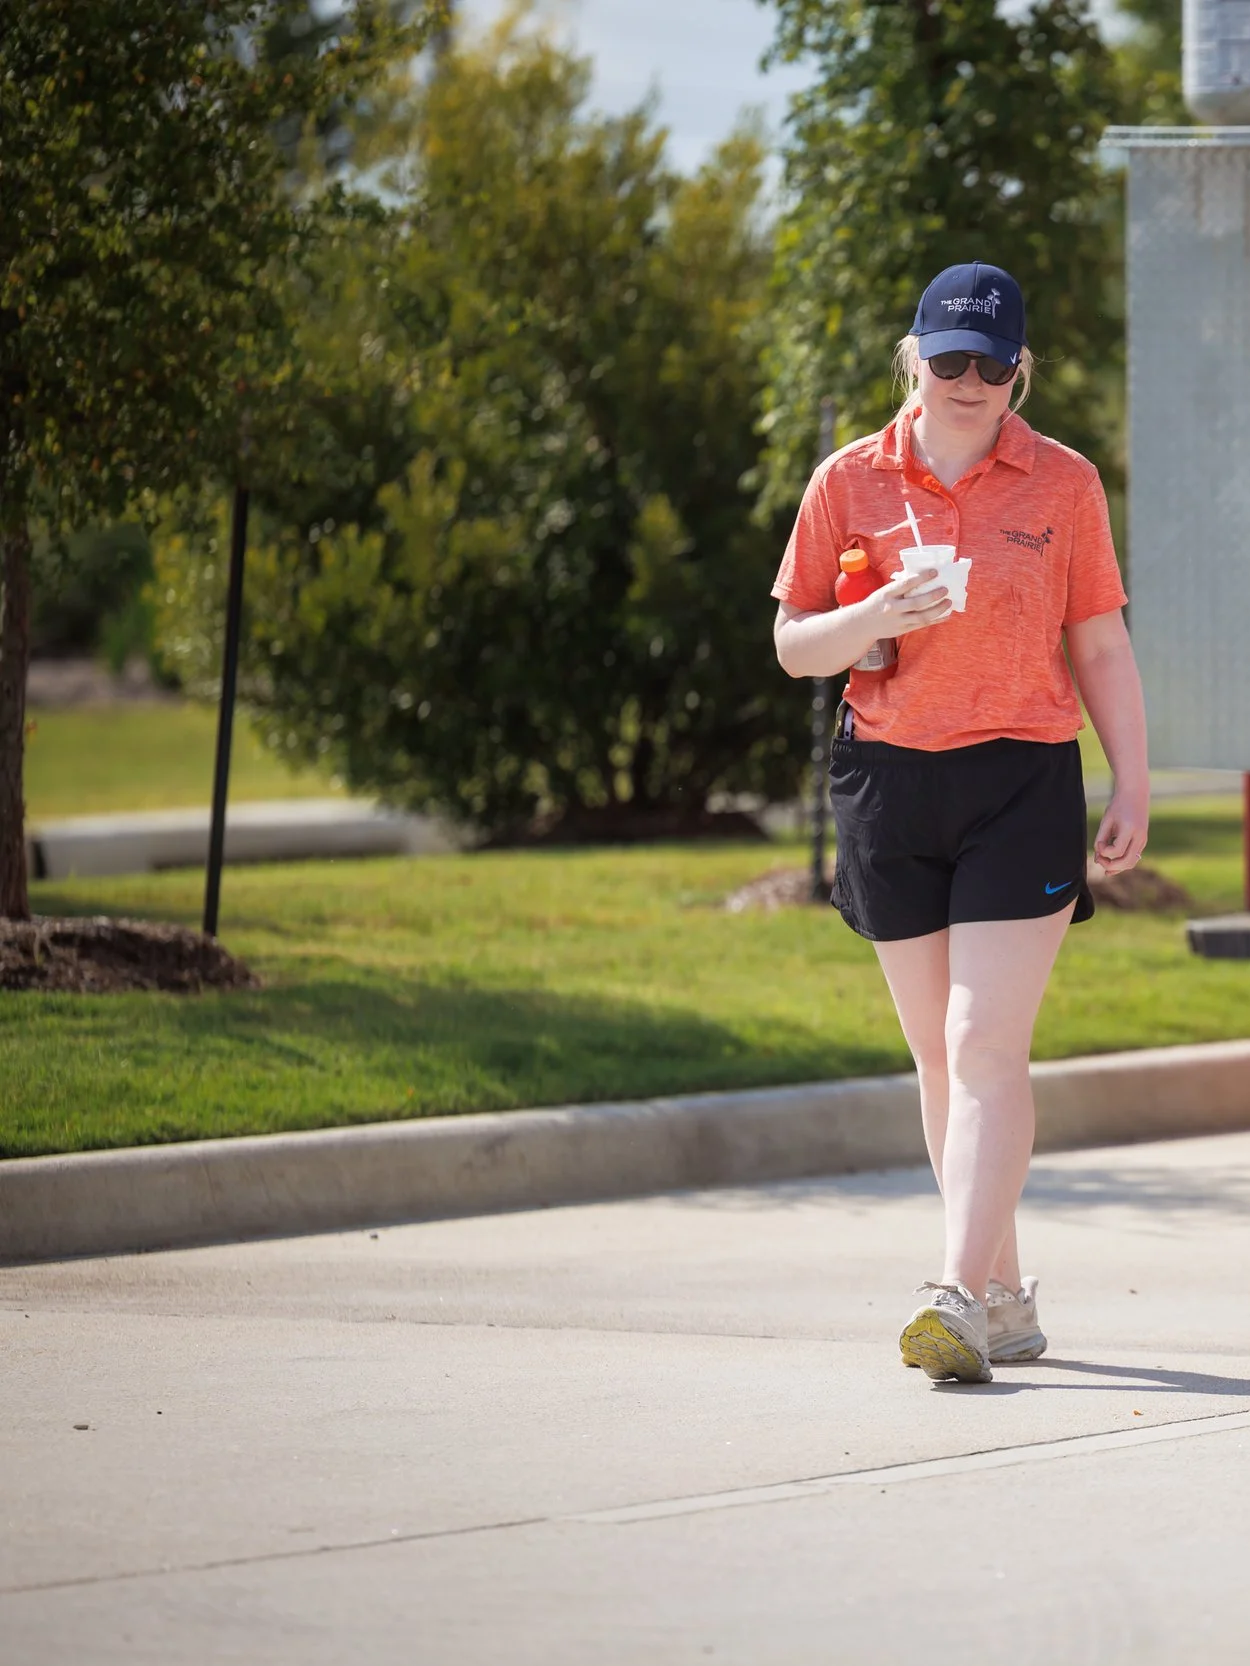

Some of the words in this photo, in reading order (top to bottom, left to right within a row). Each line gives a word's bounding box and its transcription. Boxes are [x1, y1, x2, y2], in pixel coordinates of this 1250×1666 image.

[952, 297, 991, 307] GRAND
[948, 304, 991, 314] PRAIRIE
[1006, 536, 1041, 551] PRAIRIE
[1011, 530, 1043, 545] GRAND
